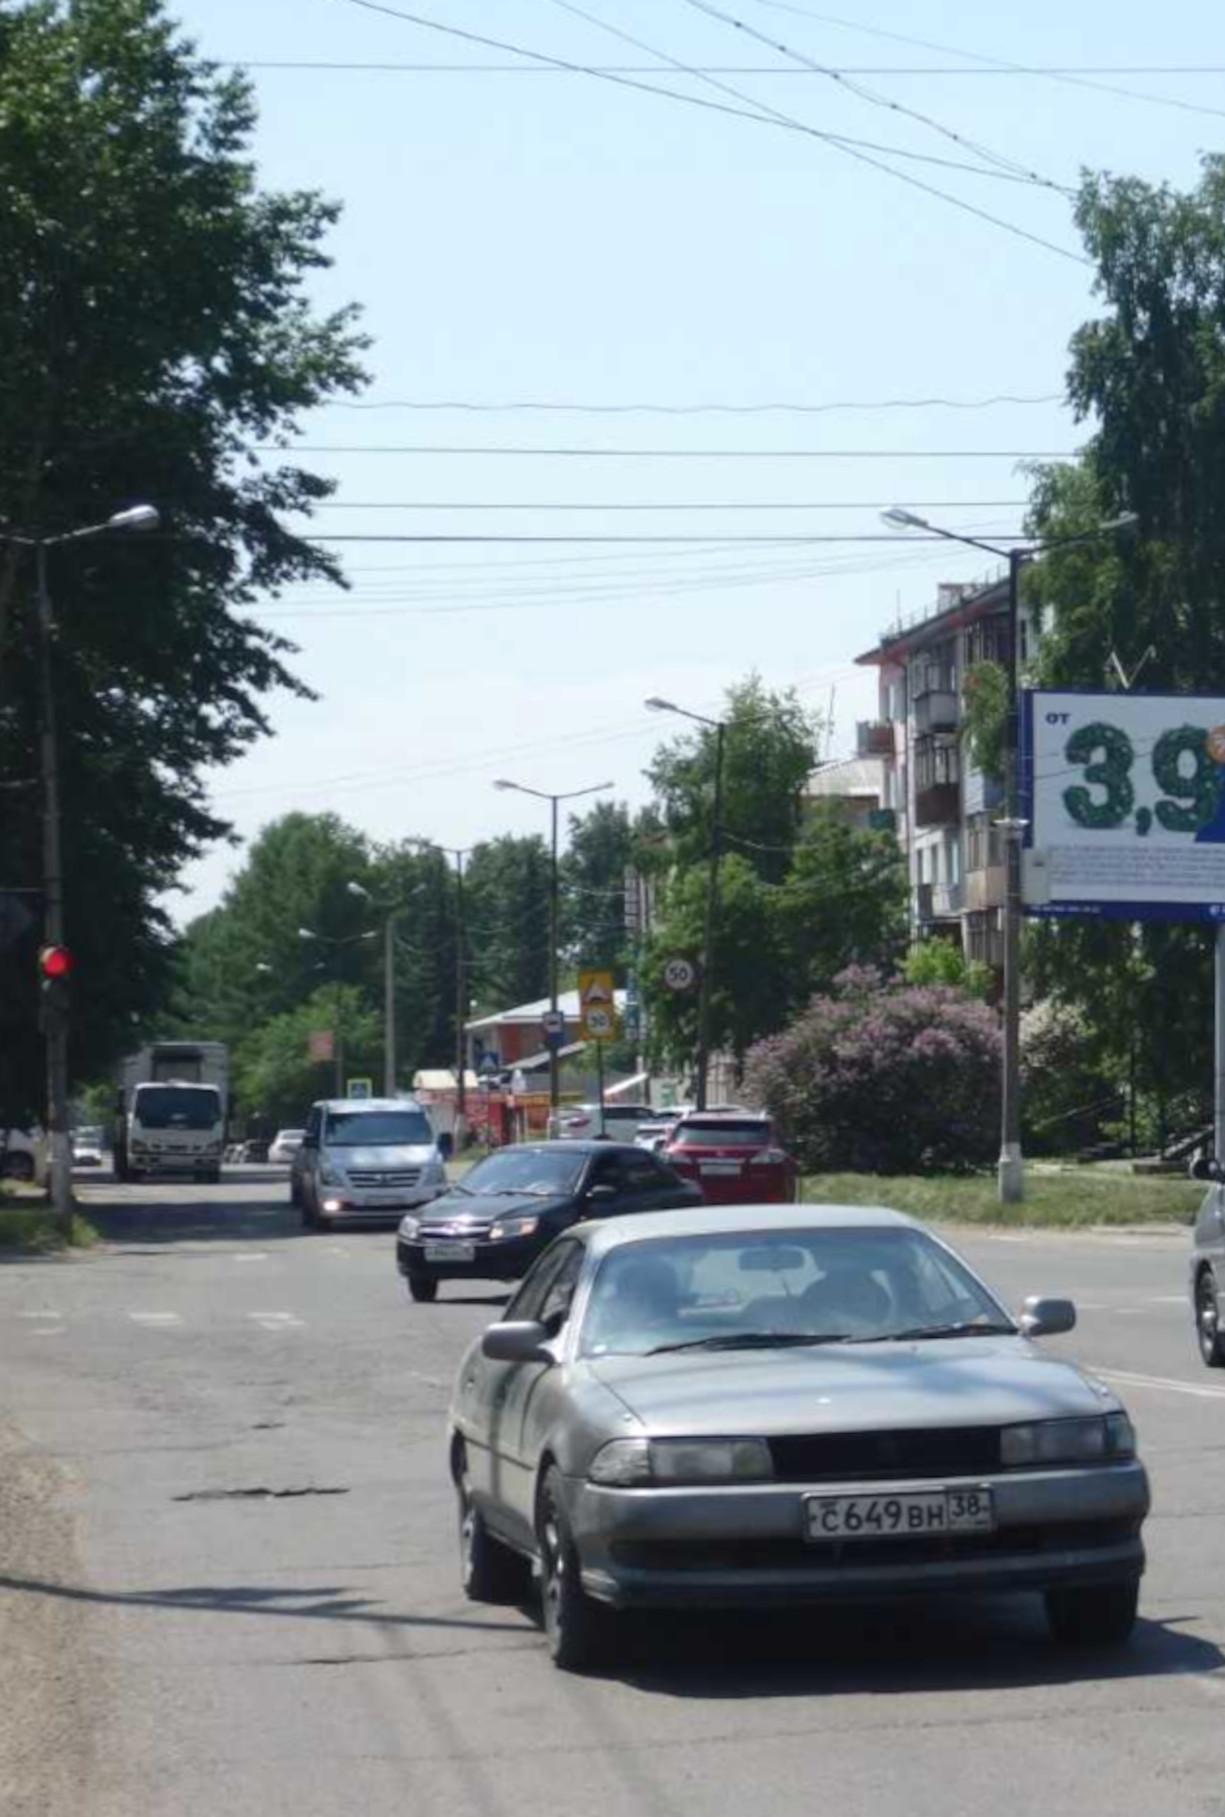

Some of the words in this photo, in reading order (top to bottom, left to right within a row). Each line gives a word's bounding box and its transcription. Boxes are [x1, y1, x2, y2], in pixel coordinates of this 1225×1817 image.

[1045, 712, 1071, 725] от
[669, 966, 688, 980] 50
[821, 1501, 944, 1533] С649ВН
[951, 1494, 982, 1518] 38
